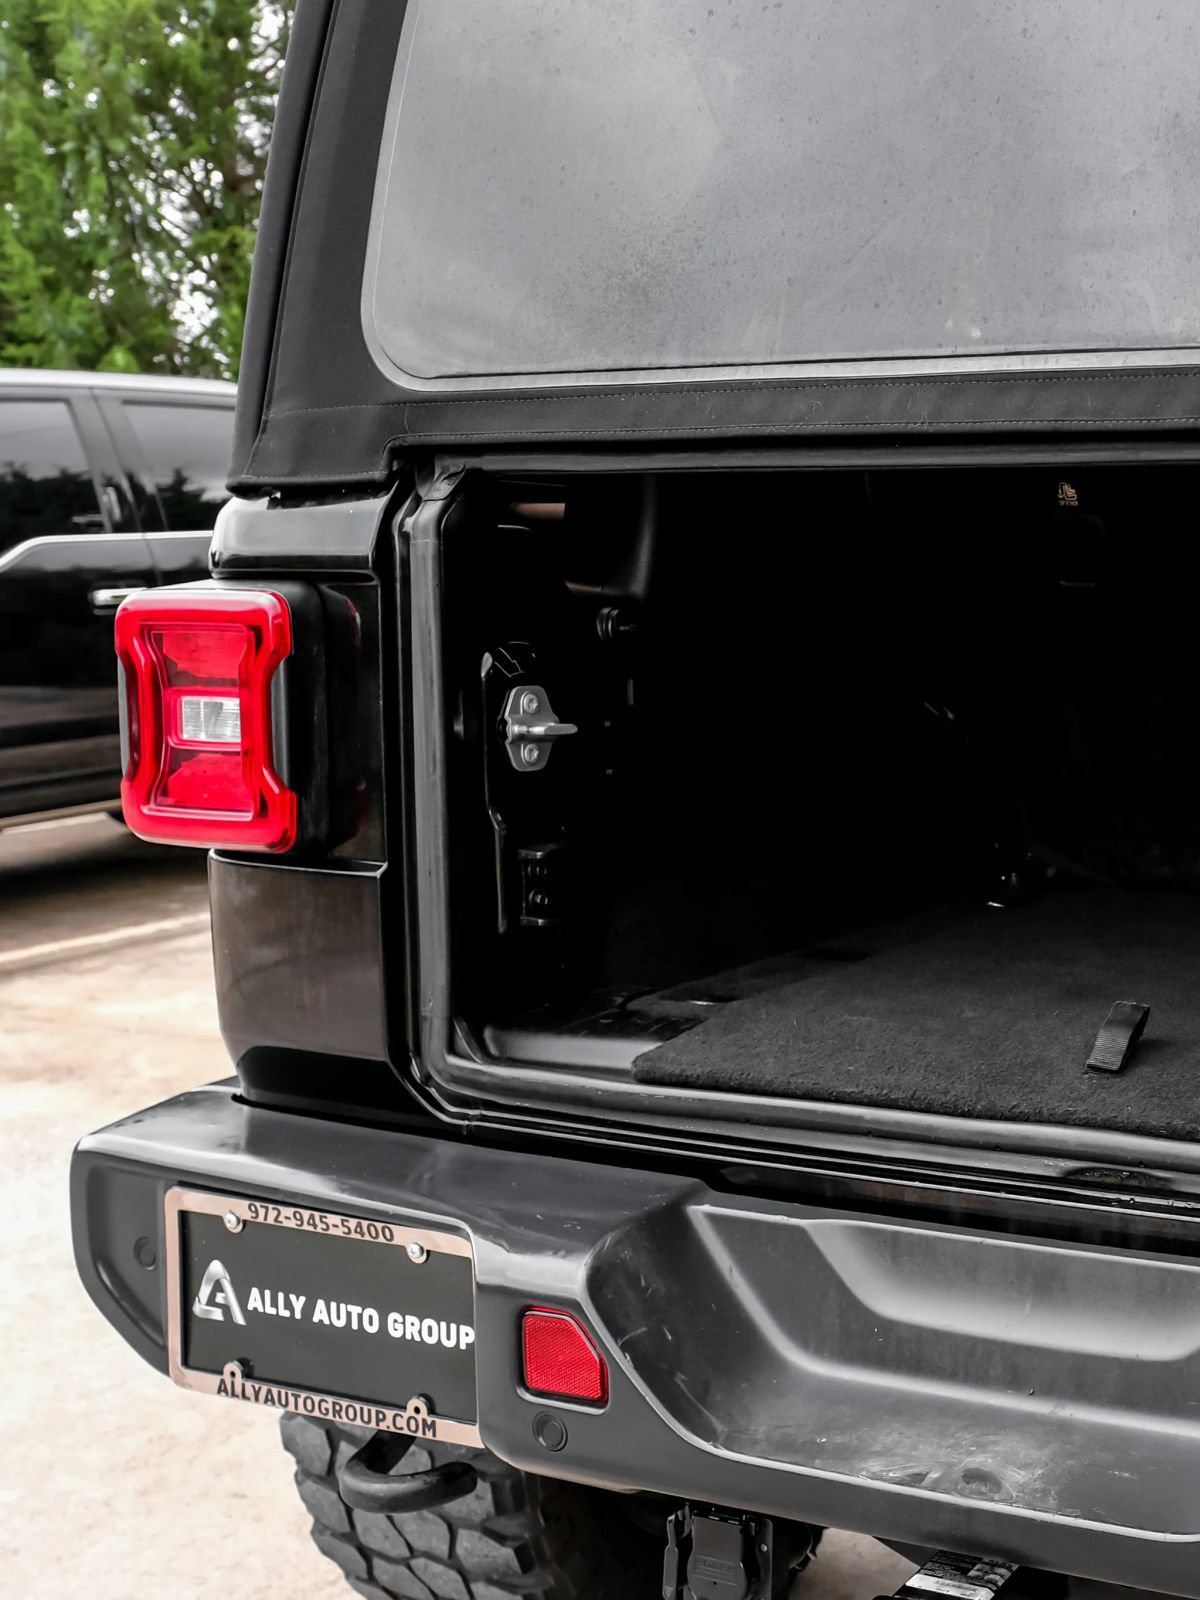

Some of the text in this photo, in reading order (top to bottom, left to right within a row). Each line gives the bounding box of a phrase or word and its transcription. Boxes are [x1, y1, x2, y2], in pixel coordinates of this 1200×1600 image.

[247, 1202, 395, 1243] 972-945-5400
[247, 1286, 476, 1350] ALLY AUTO GROUP
[216, 1377, 437, 1438] ALLYAUTOGROUP.COM
